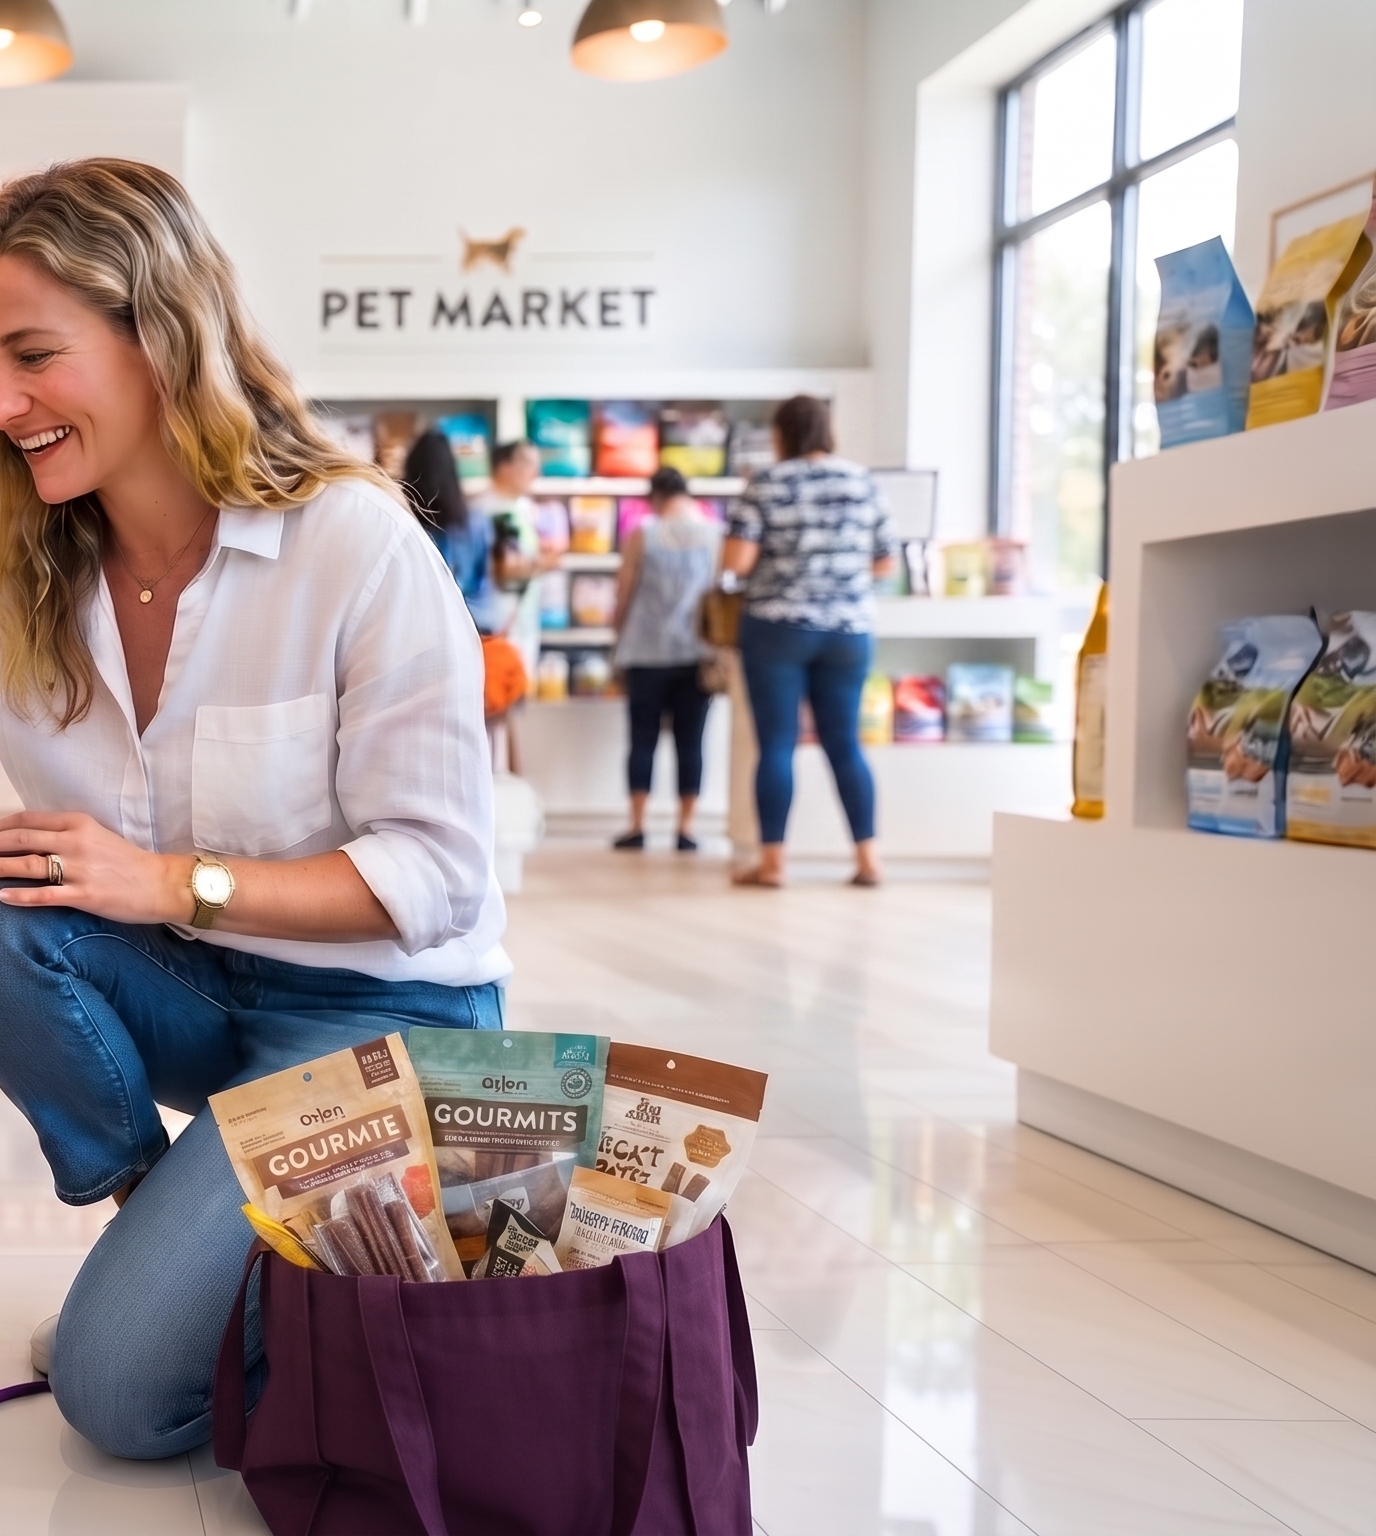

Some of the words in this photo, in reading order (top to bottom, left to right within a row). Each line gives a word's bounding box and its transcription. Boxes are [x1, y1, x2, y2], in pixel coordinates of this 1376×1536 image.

[320, 288, 412, 329] PET
[432, 288, 656, 329] MARKET
[434, 1103, 578, 1132] GOURMITS
[268, 1113, 401, 1176] GOURMTE
